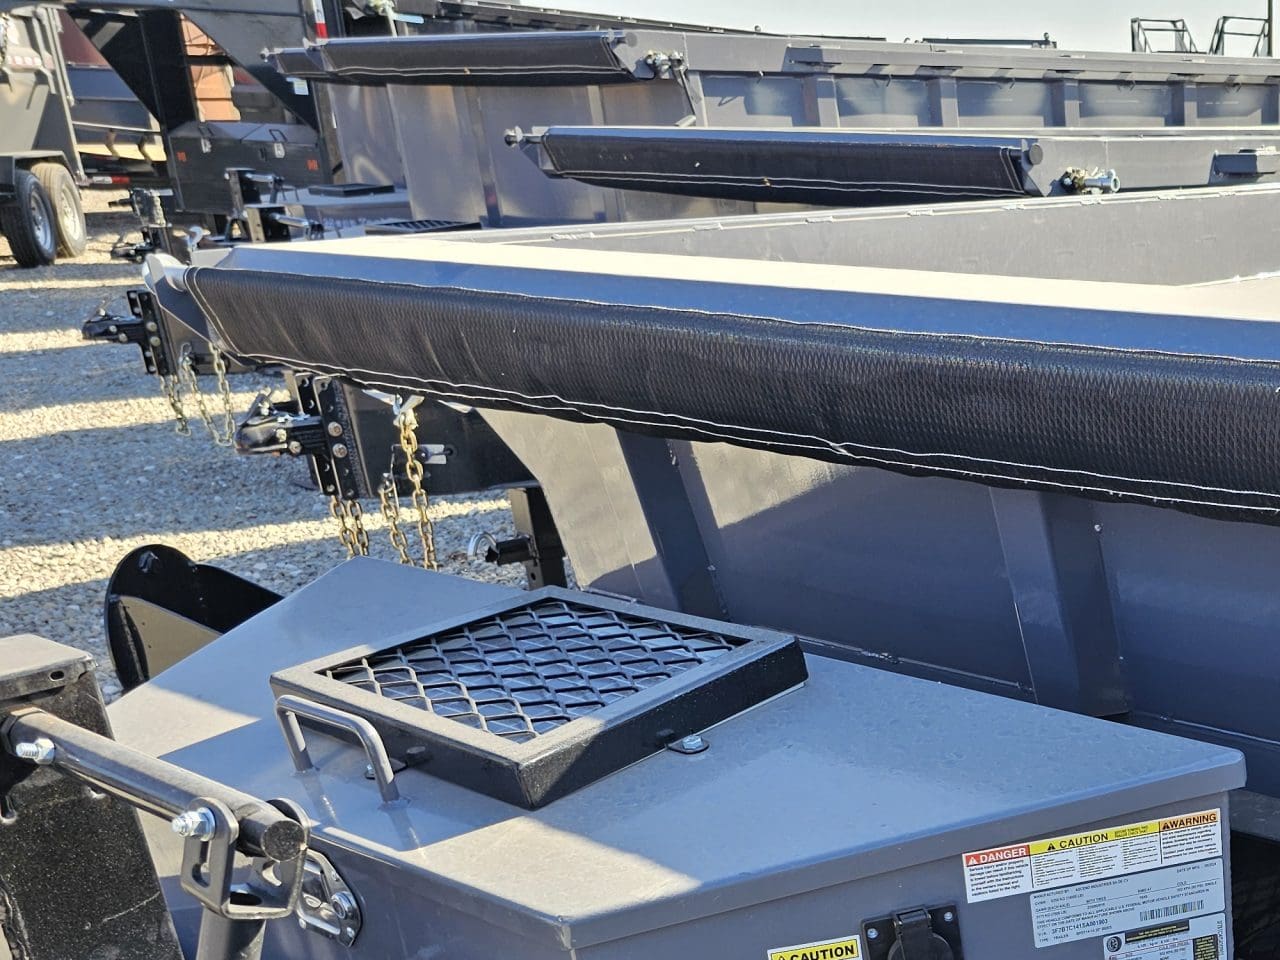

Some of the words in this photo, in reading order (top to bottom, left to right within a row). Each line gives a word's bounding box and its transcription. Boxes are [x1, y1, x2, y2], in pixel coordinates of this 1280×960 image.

[1169, 814, 1216, 828] WARNING
[1059, 833, 1108, 849] CAUTION
[979, 848, 1026, 863] DANGER
